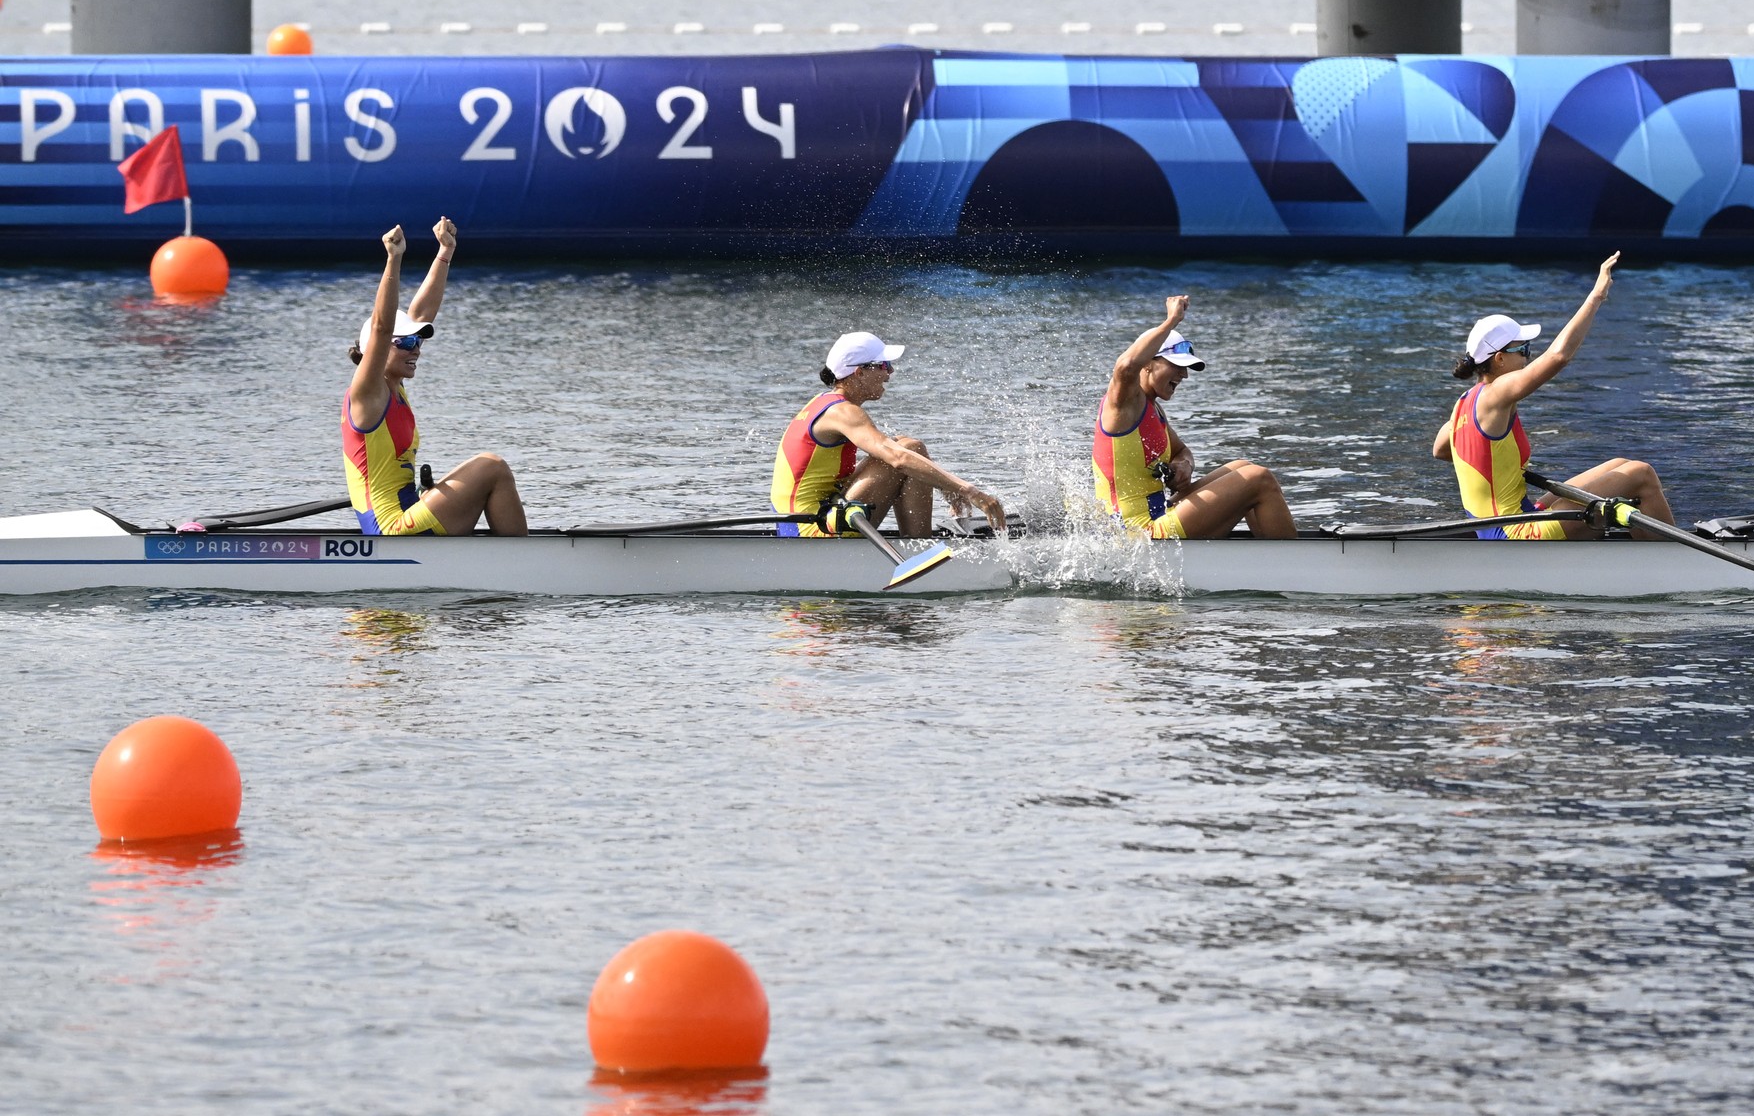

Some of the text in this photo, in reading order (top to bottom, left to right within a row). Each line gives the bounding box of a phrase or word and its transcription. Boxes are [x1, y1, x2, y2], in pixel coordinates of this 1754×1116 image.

[458, 86, 797, 162] 2024
[259, 541, 309, 553] 2024
[325, 539, 373, 557] ROU
